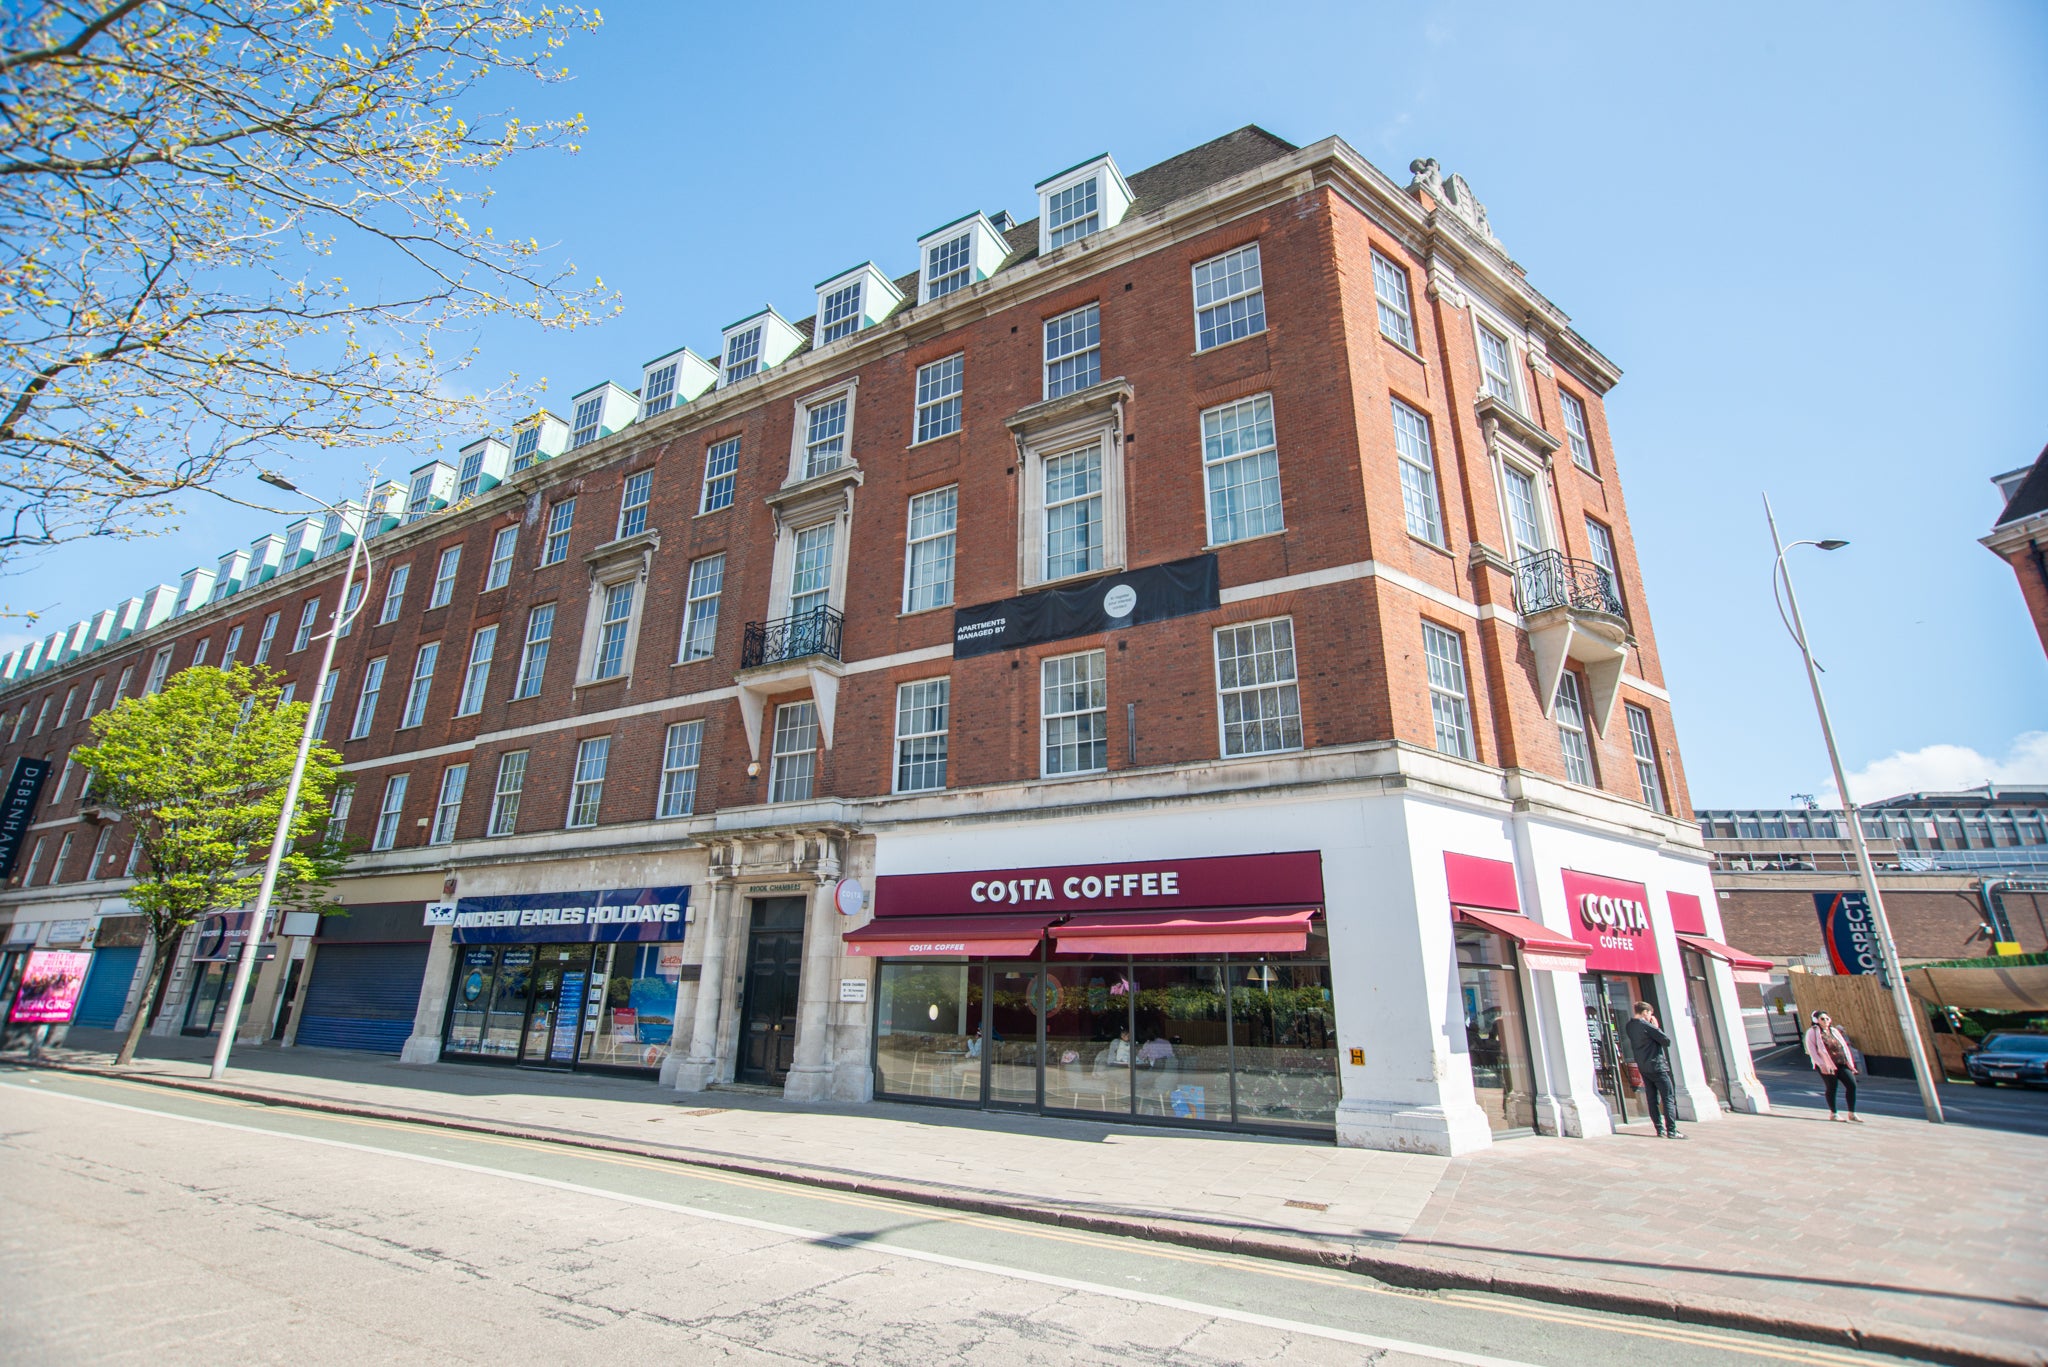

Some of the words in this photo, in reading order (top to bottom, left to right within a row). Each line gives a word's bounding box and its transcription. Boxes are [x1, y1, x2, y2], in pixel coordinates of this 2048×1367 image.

[957, 617, 1006, 633] APARTMENTS
[957, 628, 994, 641] MANAGED
[994, 626, 1006, 634] BY
[0, 767, 39, 868] DEBENHAM
[769, 884, 801, 892] CHAMBERS
[842, 890, 861, 899] COSTA
[971, 879, 1054, 904] COSTA
[1063, 872, 1179, 899] COFFEE
[453, 910, 521, 928] ANDREW
[519, 907, 585, 926] EARLES
[586, 904, 681, 924] HOLIDAYS
[1581, 893, 1649, 931] COSTA
[909, 944, 932, 952] COSTA
[934, 943, 965, 951] COFFEE
[1600, 936, 1634, 951] COFFEE
